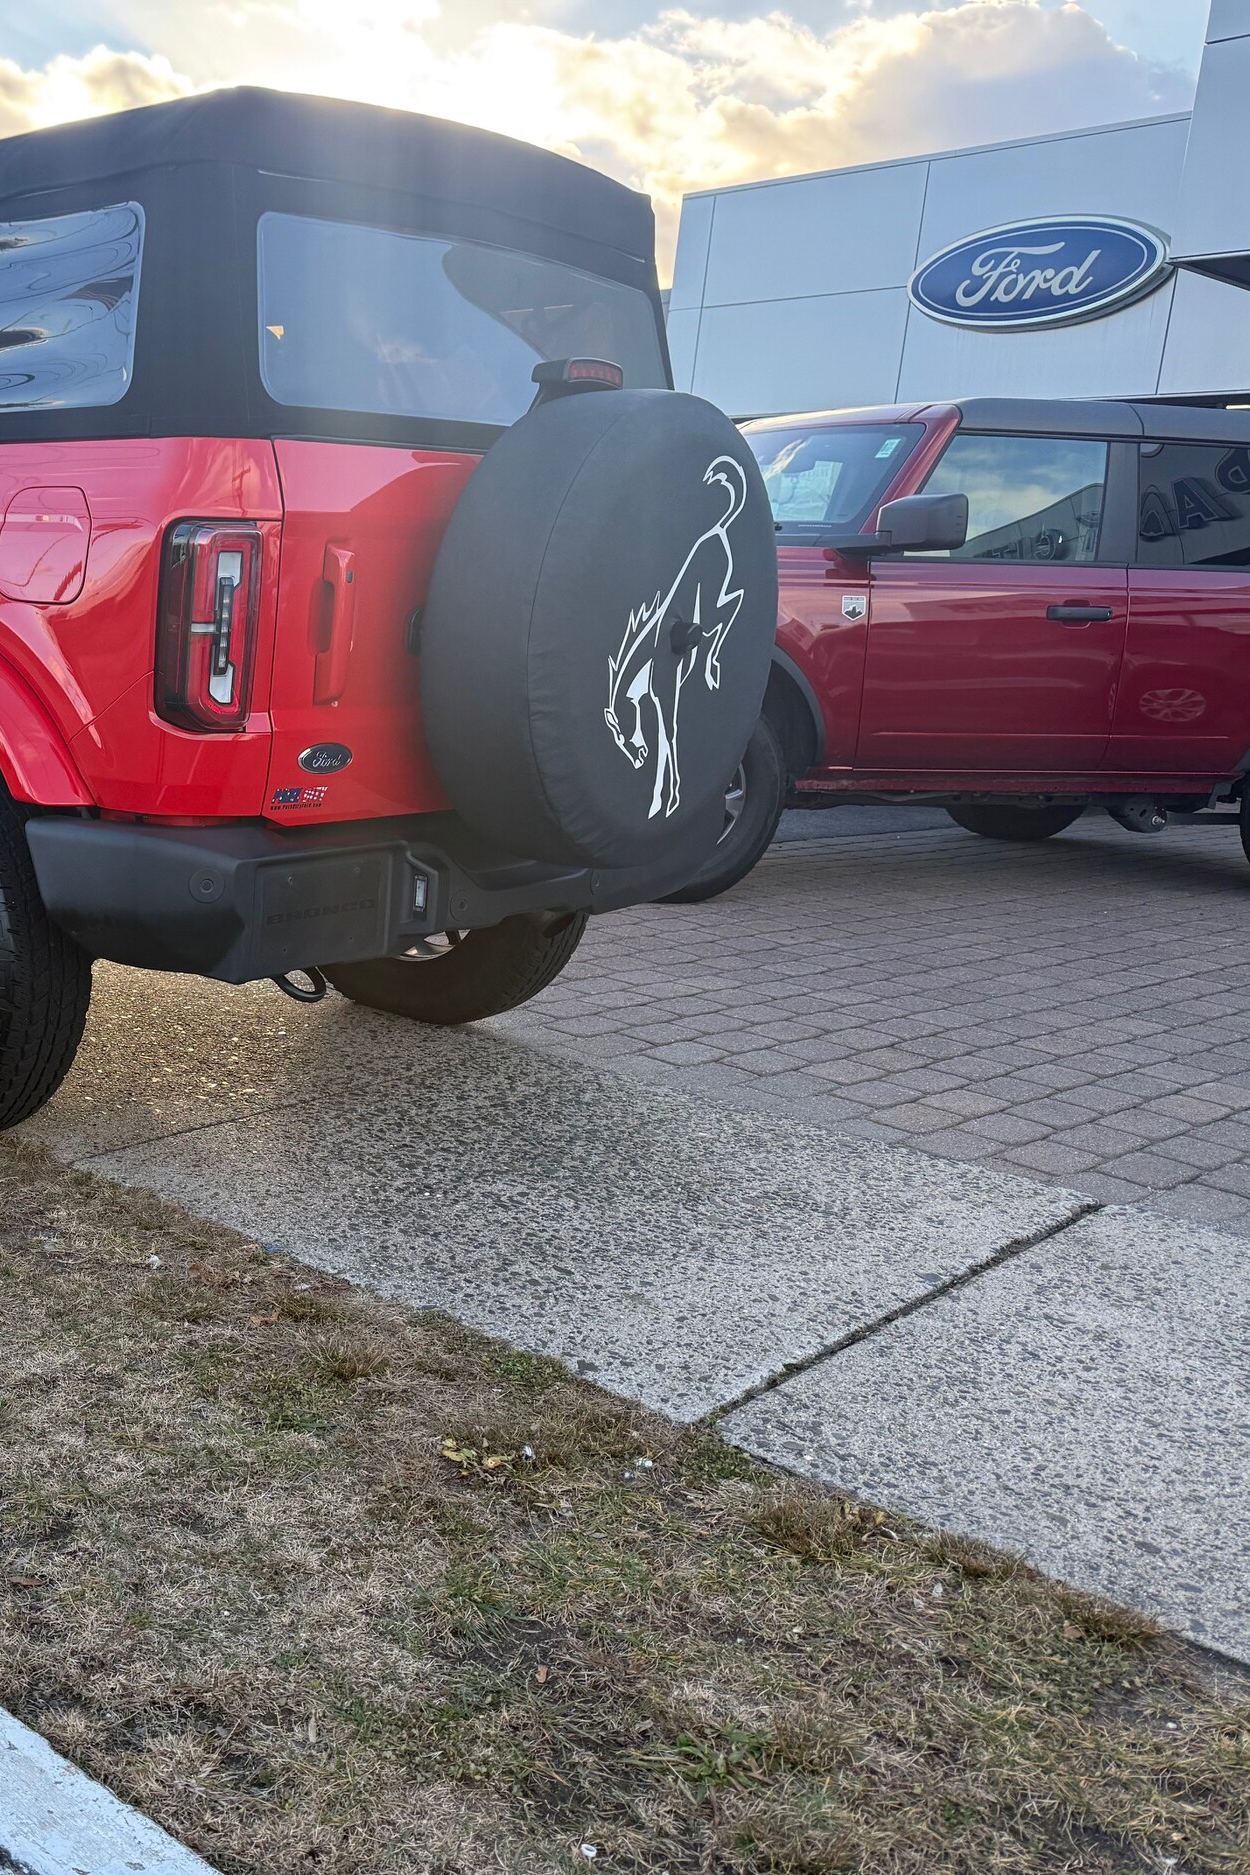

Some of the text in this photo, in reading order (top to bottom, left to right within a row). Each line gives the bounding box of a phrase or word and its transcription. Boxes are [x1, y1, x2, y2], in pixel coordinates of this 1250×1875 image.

[955, 241, 1101, 307] Ford
[312, 751, 342, 768] Ford
[266, 898, 376, 926] BRONCO
